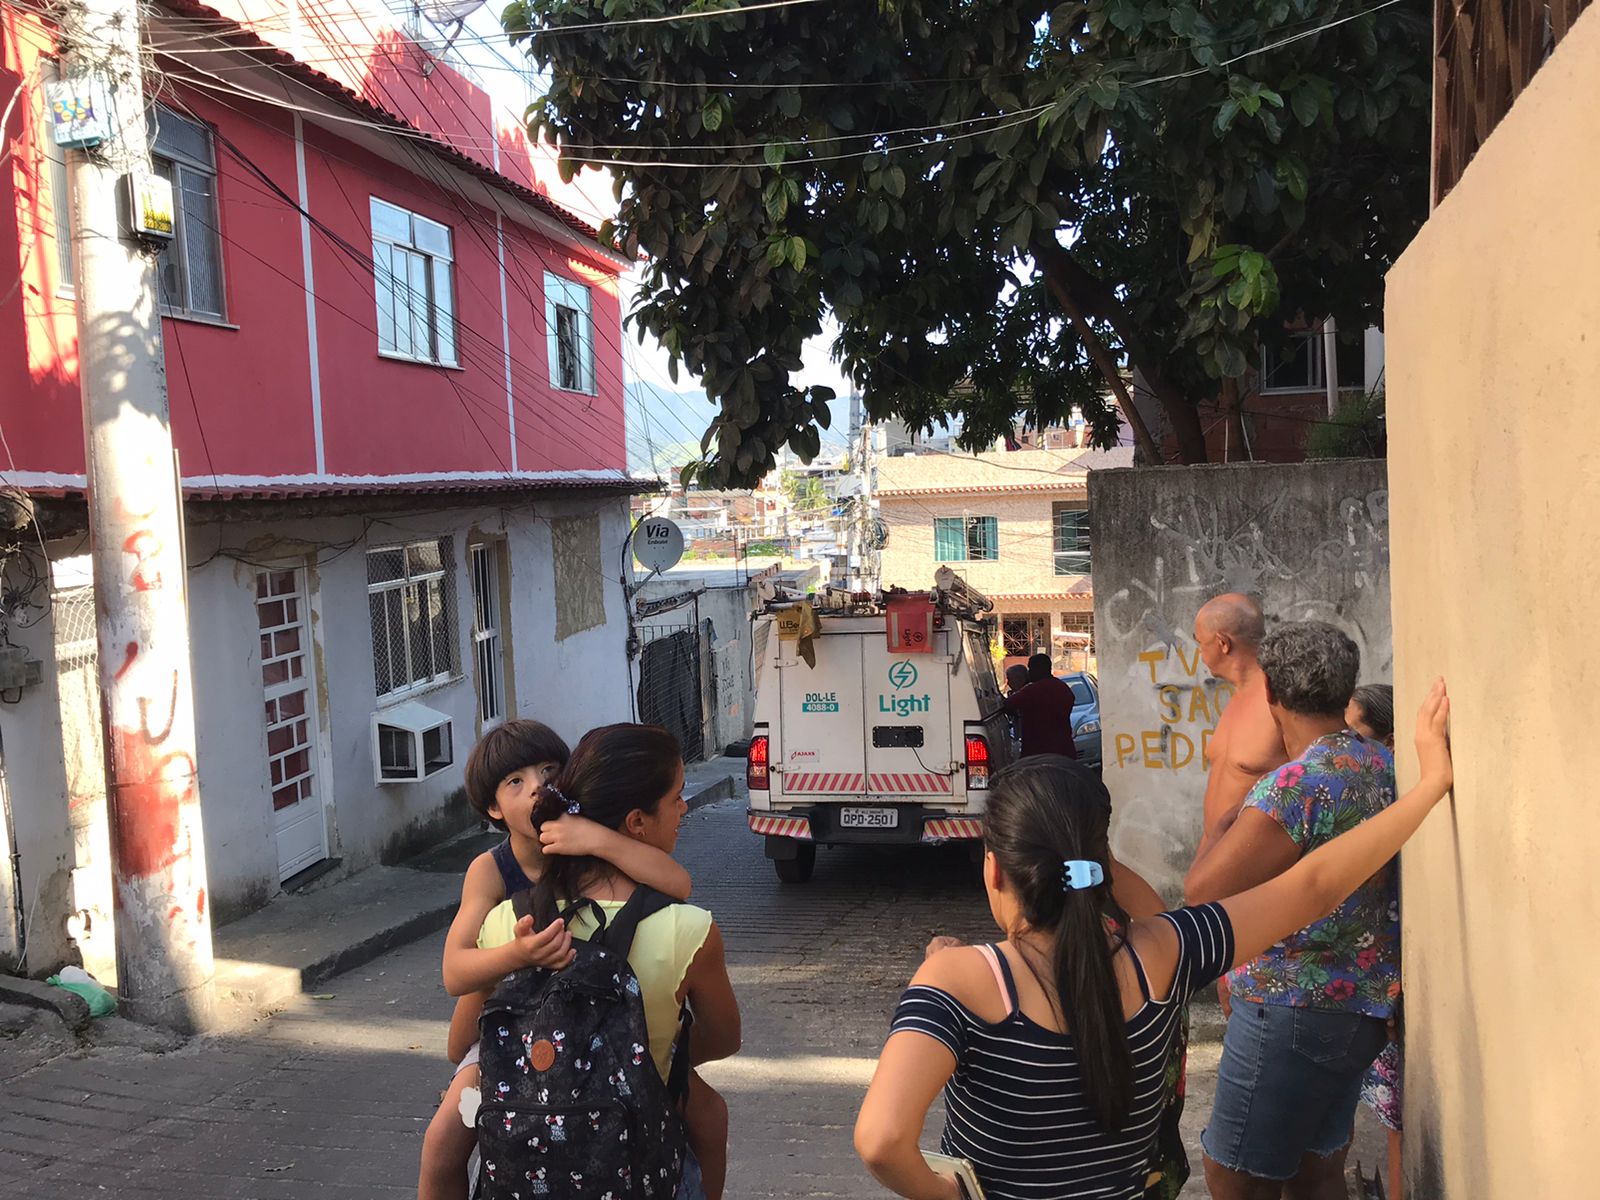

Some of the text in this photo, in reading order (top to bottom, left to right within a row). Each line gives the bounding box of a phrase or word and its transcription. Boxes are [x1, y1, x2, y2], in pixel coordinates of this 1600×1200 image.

[646, 524, 669, 538] Via
[805, 692, 836, 702] DOL-LE
[879, 694, 931, 717] Light
